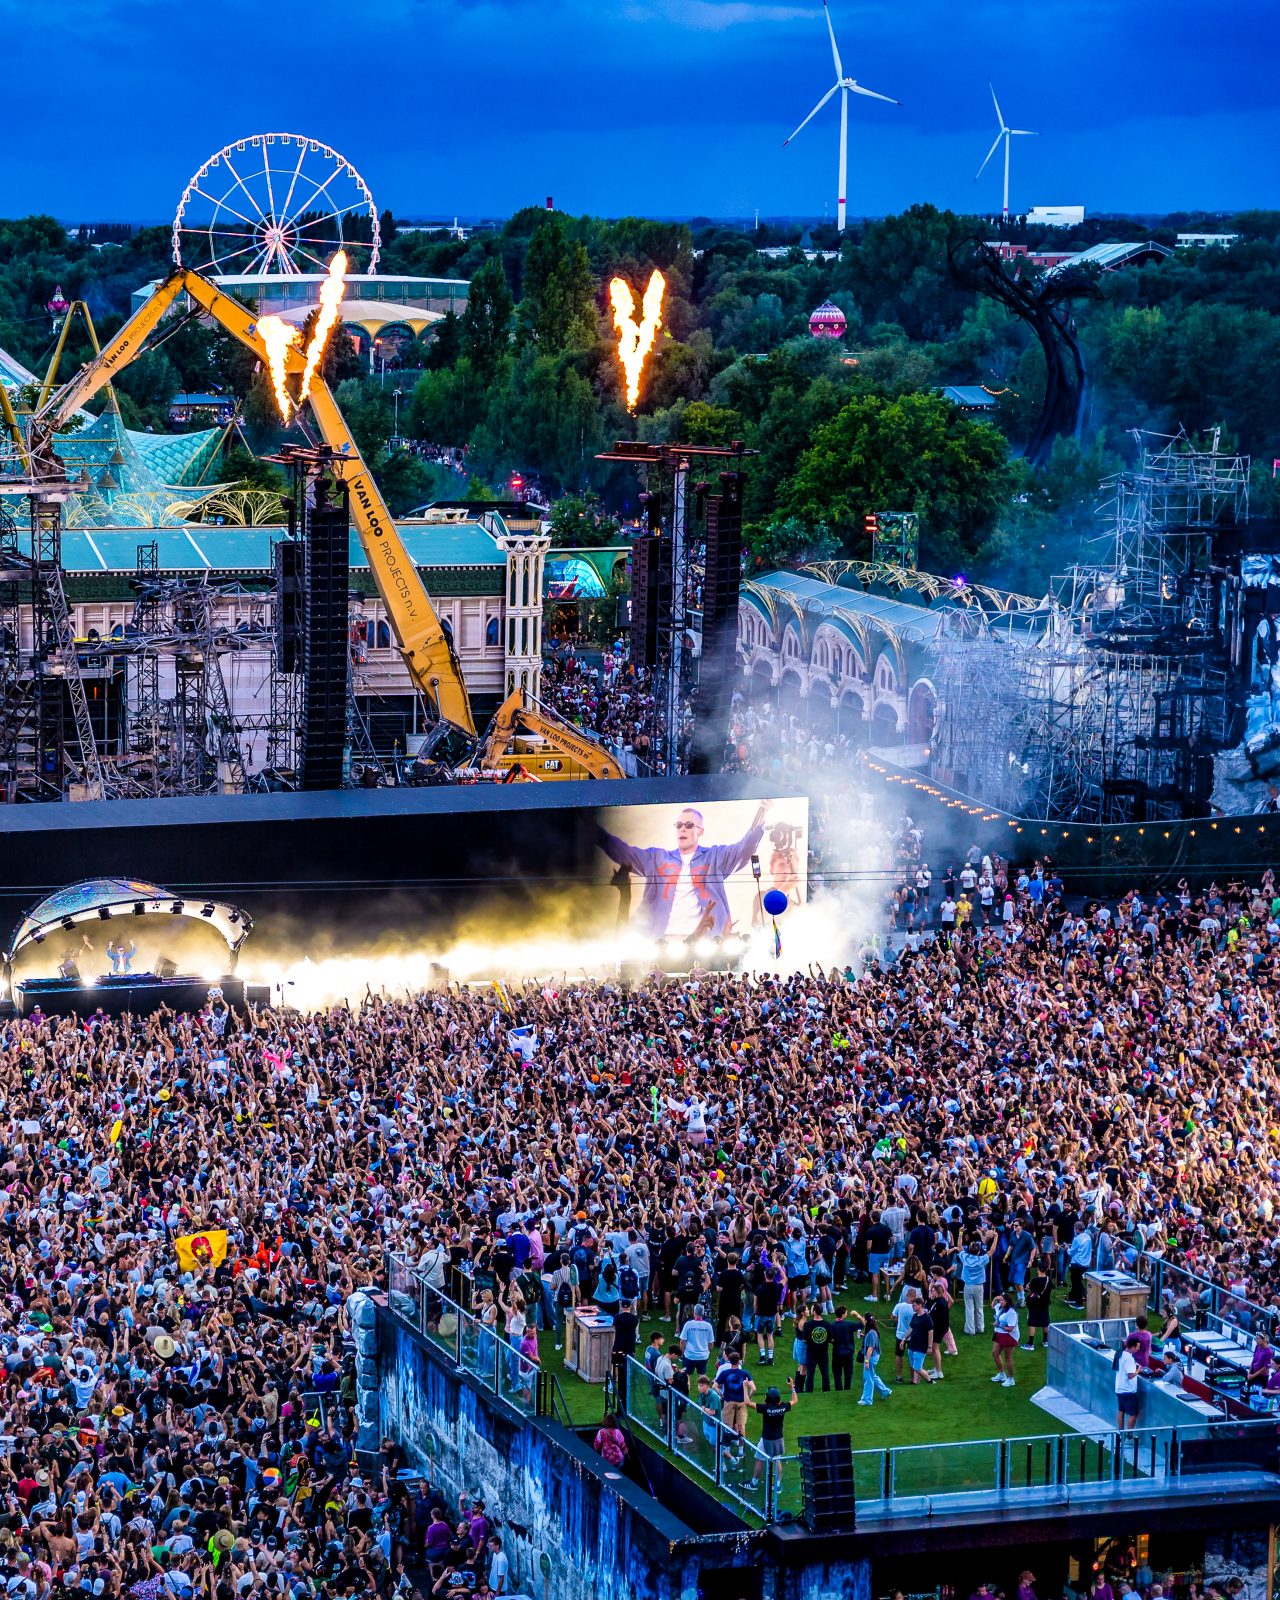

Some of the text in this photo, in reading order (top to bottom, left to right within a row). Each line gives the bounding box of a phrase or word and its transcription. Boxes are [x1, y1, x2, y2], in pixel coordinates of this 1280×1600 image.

[104, 354, 118, 369] VAN
[118, 340, 129, 355] LOO
[128, 310, 155, 341] PROJECTS
[353, 480, 372, 510] VAN
[366, 511, 383, 538] LOO
[379, 541, 411, 600] PROJECTS
[539, 726, 550, 738] VAN
[550, 732, 560, 742] LOO
[559, 738, 584, 757] PROJECTS
[544, 760, 559, 770] CAT
